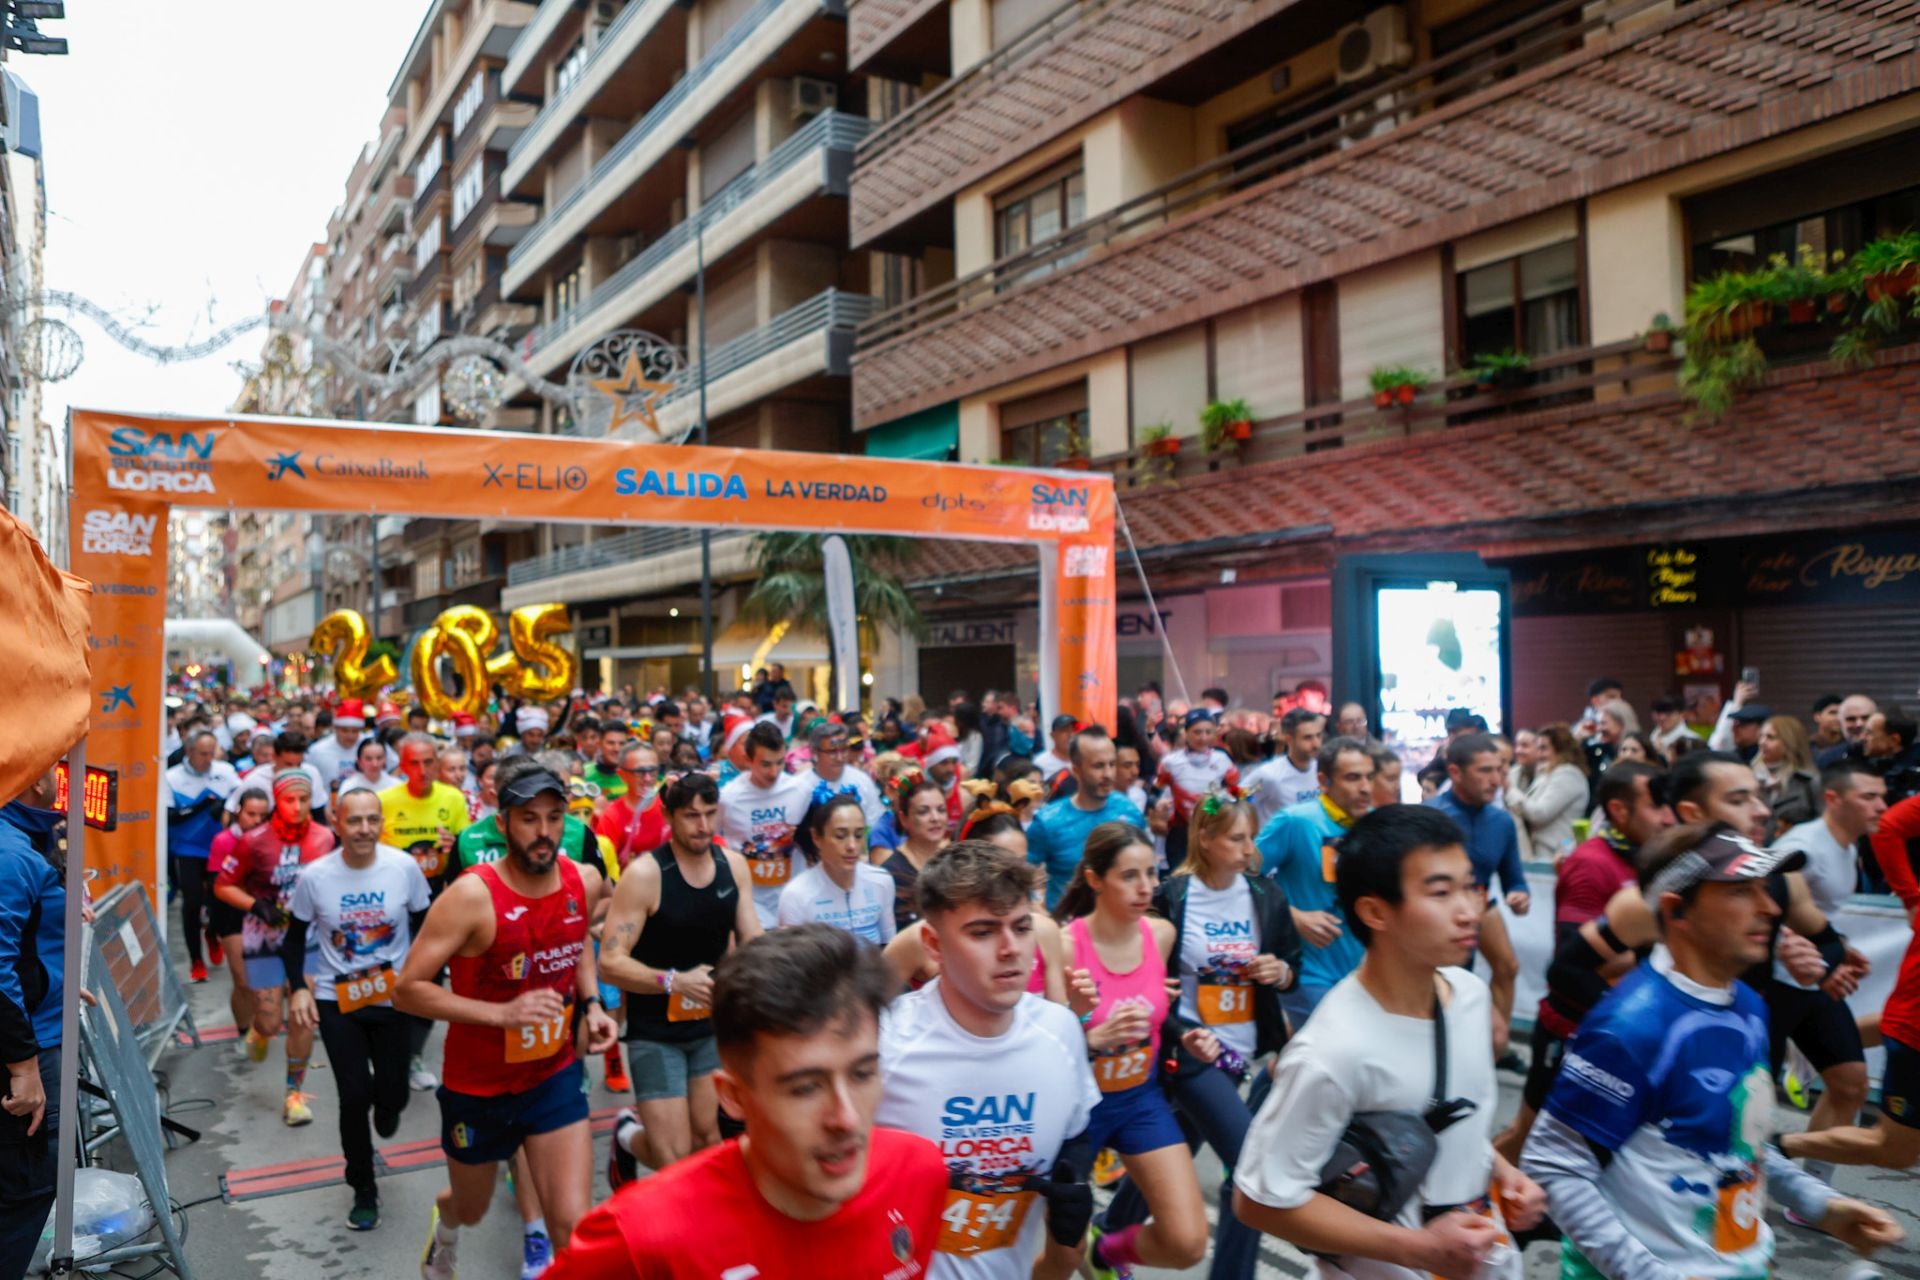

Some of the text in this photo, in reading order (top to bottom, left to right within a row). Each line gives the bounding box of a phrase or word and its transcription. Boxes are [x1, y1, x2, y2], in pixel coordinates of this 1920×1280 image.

[108, 427, 216, 459] SAN
[314, 455, 430, 480] CaixaBank
[106, 467, 216, 494] LORCA
[614, 467, 748, 500] SALIDA
[765, 479, 888, 504] LA VERDAD
[1031, 484, 1088, 506] SAN
[83, 510, 158, 536] SAN
[751, 806, 786, 821] SAN
[754, 861, 785, 878] 473
[340, 891, 385, 907] SAN
[1204, 920, 1251, 936] SAN
[348, 975, 388, 1001] 896
[1219, 989, 1248, 1012] 81
[521, 1014, 565, 1049] 517
[1103, 1053, 1146, 1080] 122
[942, 1092, 1035, 1127] SAN
[943, 1122, 1035, 1140] SILVESTRE
[940, 1136, 1034, 1159] LORCA
[942, 1199, 1018, 1238] 434
